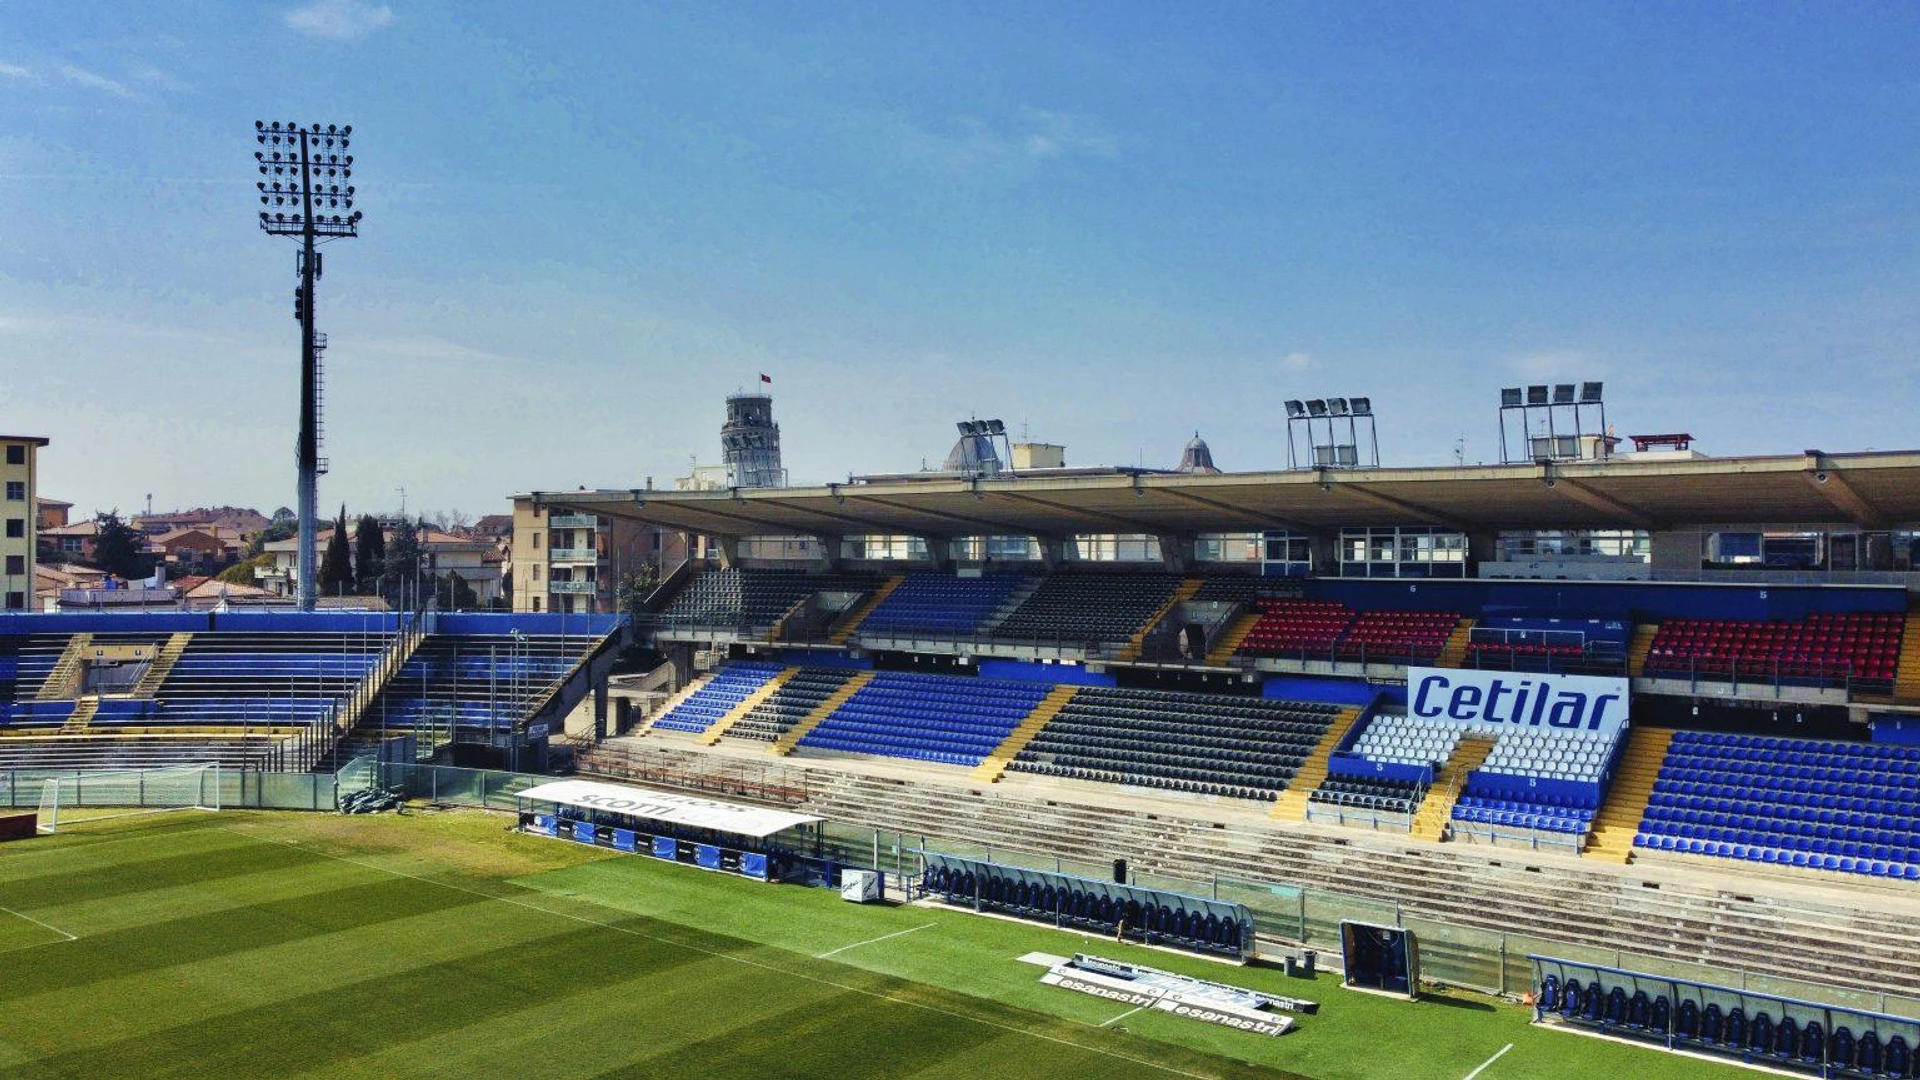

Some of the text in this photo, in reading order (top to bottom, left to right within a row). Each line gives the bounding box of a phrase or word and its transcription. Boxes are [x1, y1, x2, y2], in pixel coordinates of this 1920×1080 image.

[1413, 675, 1620, 730] Cetilar
[573, 794, 675, 815] SCOTTI
[1060, 980, 1156, 1007] esanastri
[1175, 1006, 1283, 1036] esanastri
